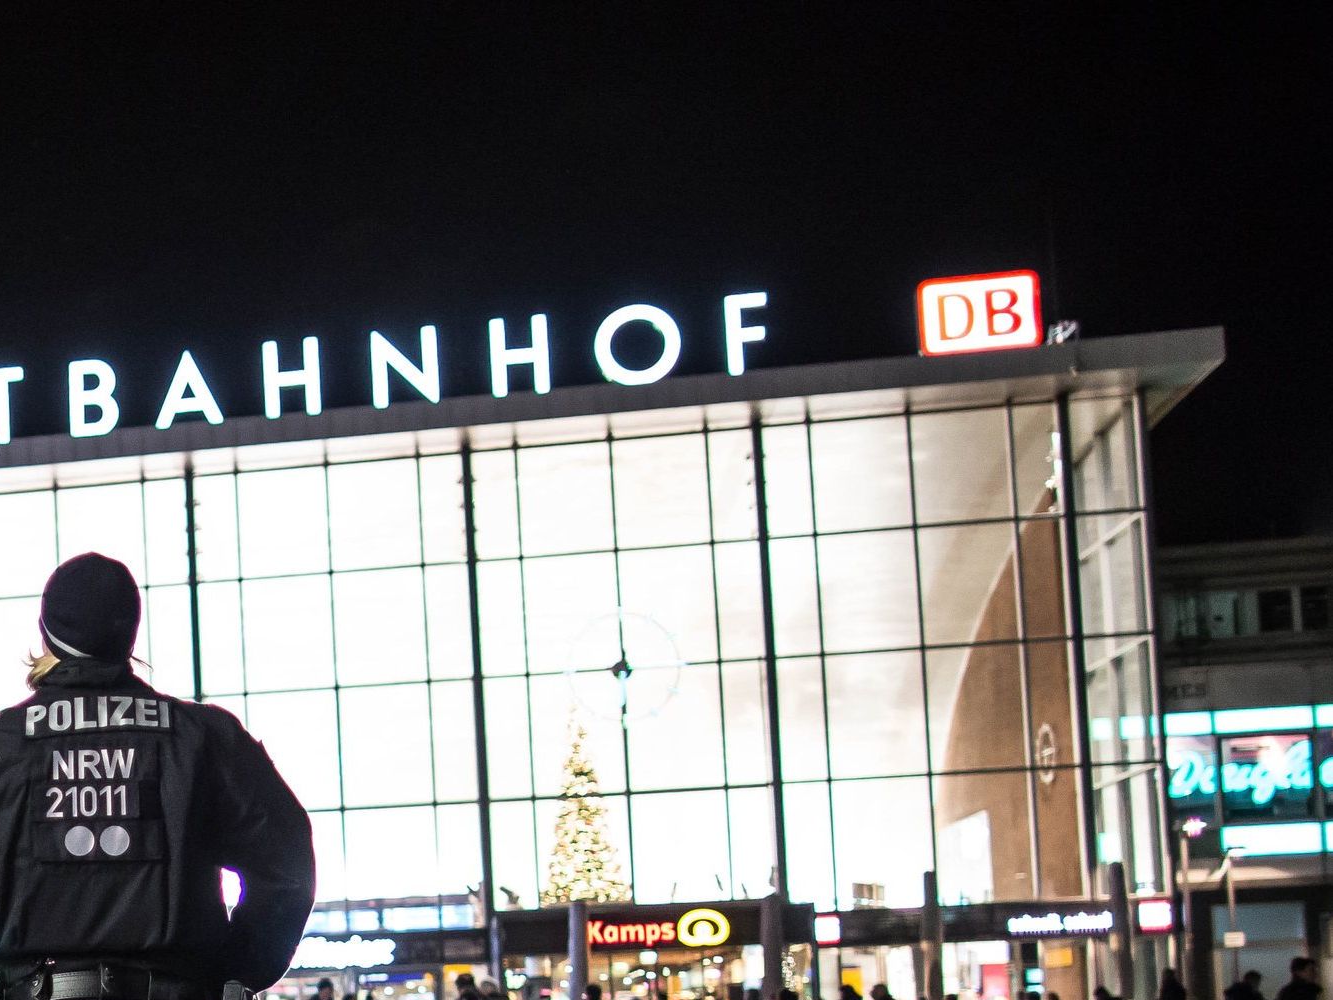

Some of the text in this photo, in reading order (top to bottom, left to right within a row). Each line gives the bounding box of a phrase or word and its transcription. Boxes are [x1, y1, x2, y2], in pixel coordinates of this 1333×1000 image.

[936, 287, 1022, 341] DB
[25, 695, 170, 736] POLIZEI
[52, 747, 135, 781] NRW
[45, 785, 128, 818] 21011
[587, 919, 676, 946] Kamps
